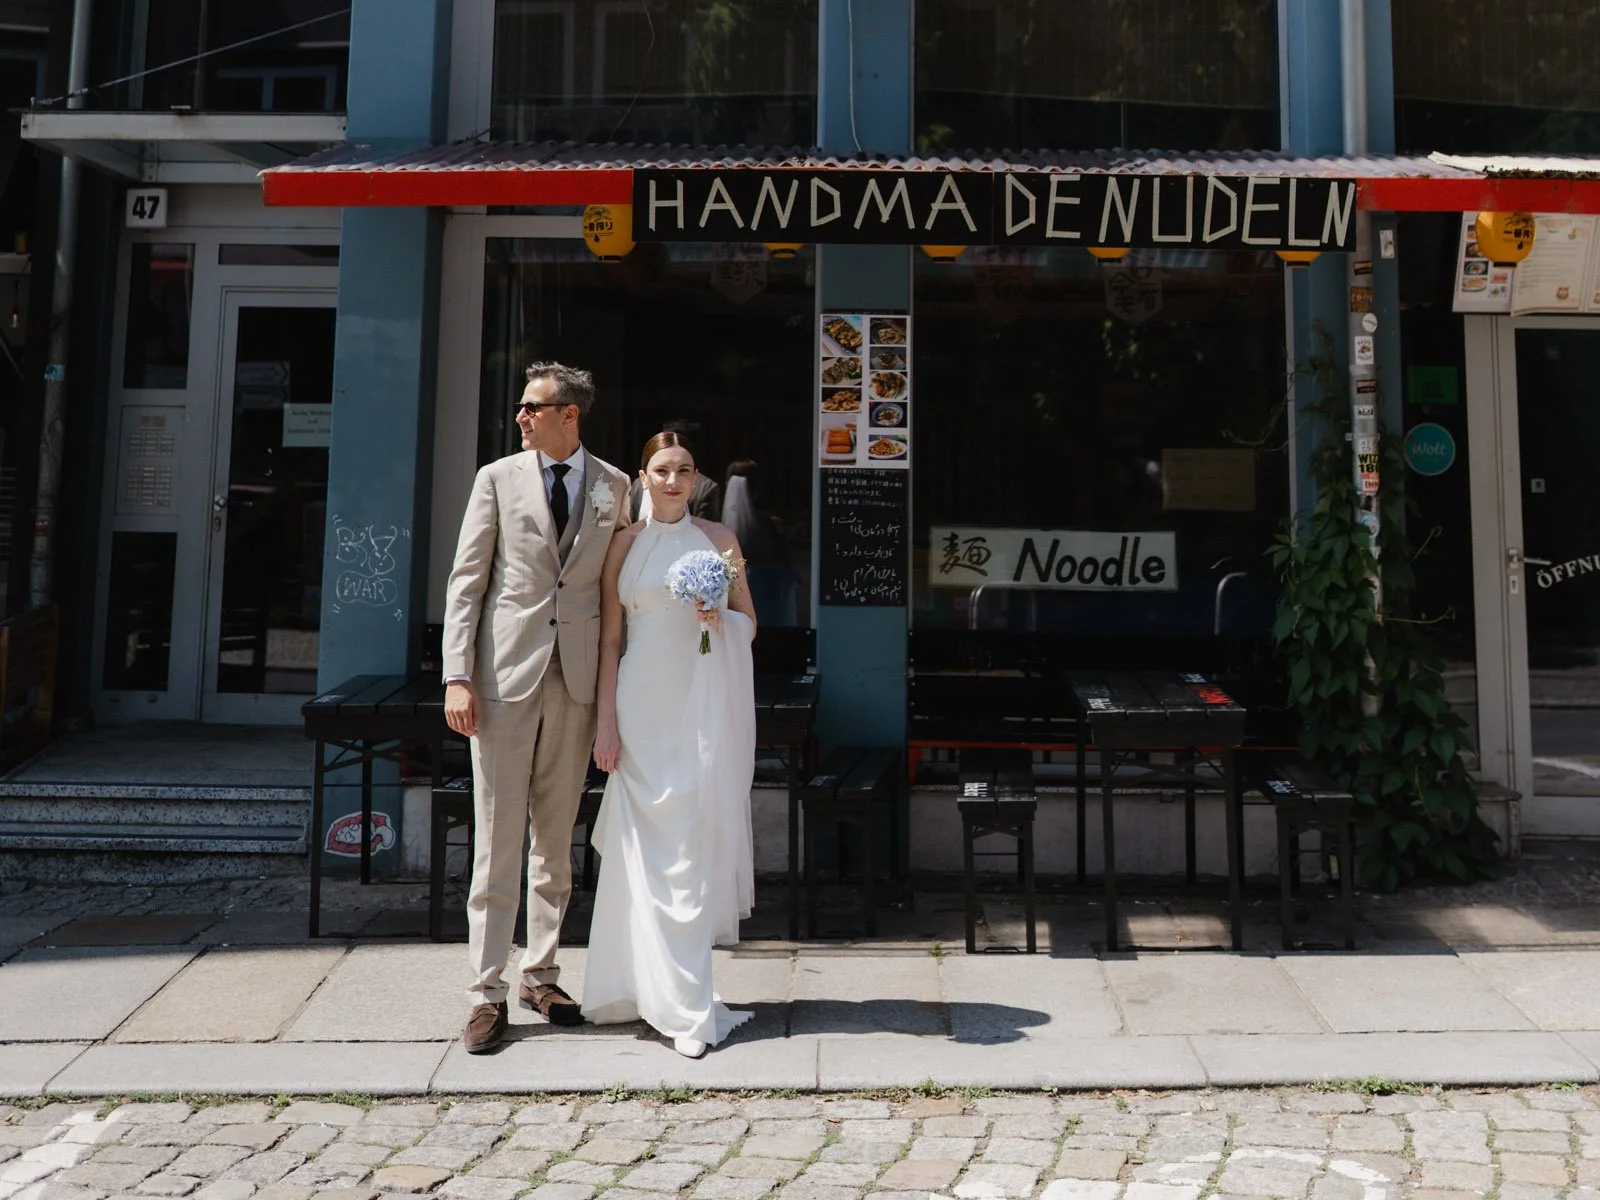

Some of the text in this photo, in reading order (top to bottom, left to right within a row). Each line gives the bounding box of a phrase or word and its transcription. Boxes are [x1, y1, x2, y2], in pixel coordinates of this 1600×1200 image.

[132, 195, 160, 220] 47
[1099, 176, 1356, 248] NUDELN
[1412, 441, 1447, 457] Wolt
[1012, 535, 1165, 586] Noodle
